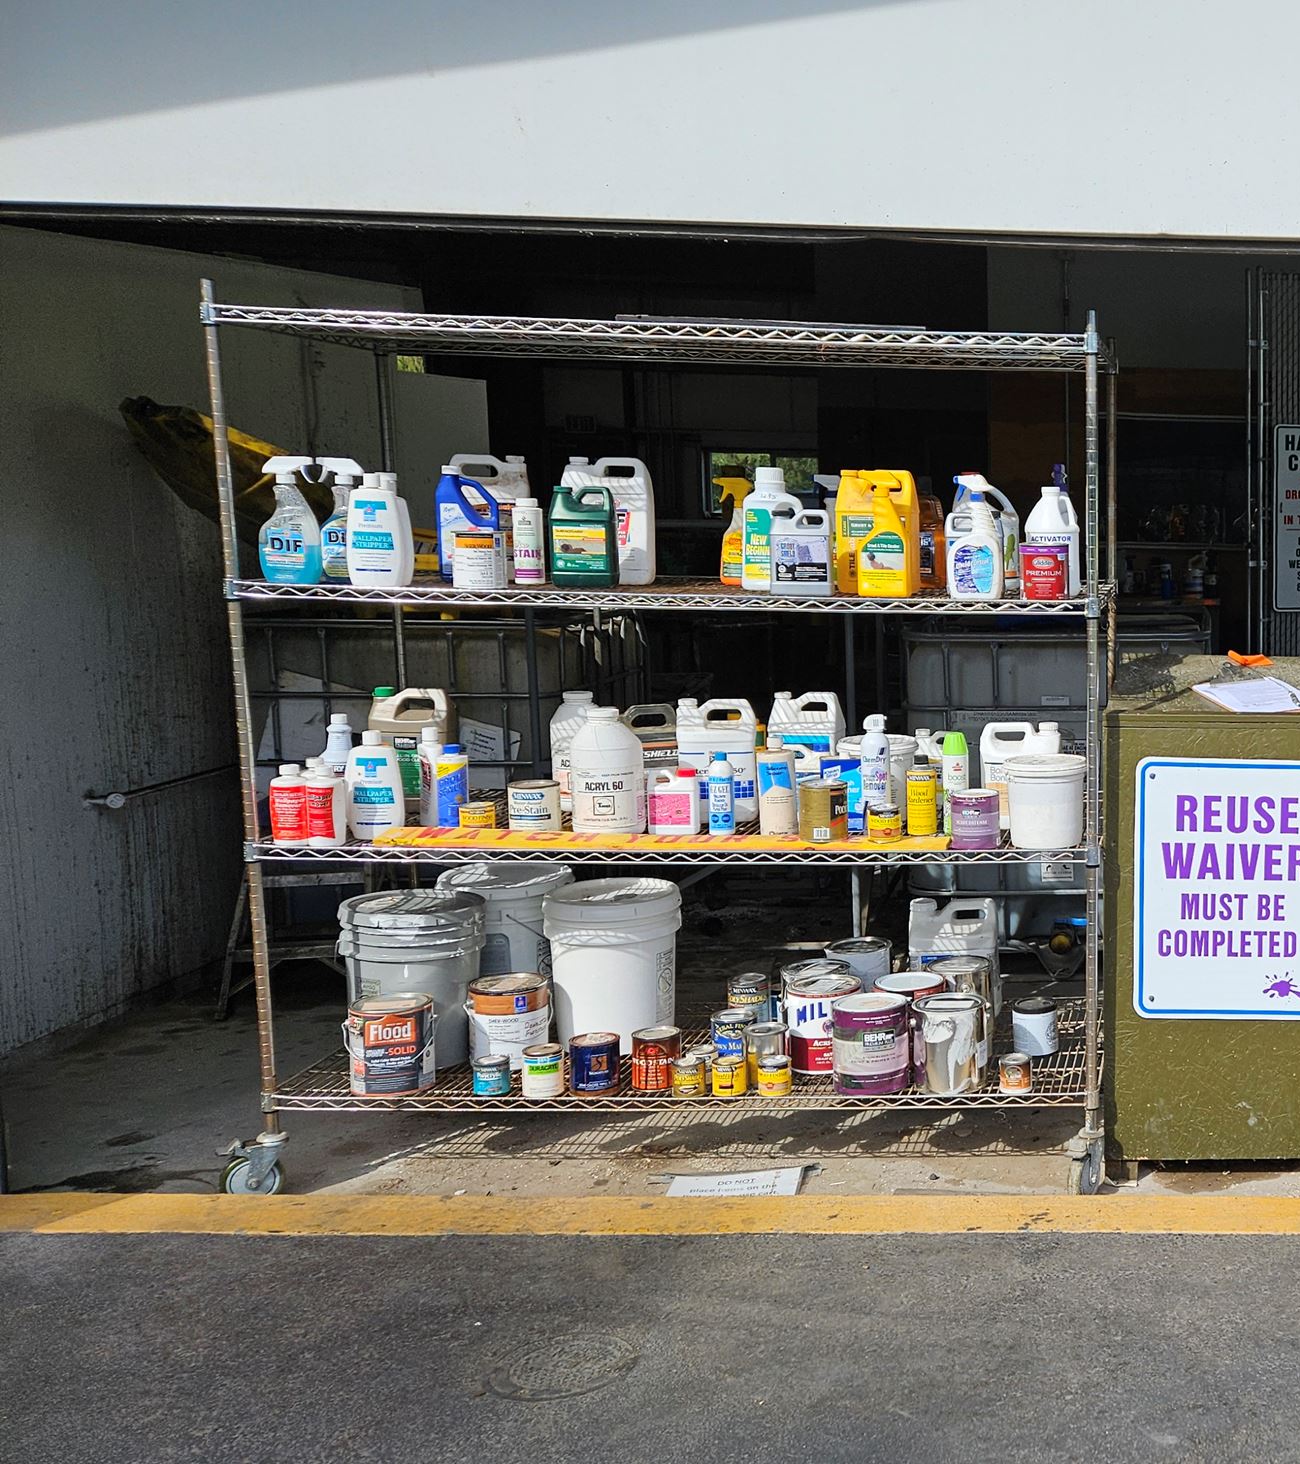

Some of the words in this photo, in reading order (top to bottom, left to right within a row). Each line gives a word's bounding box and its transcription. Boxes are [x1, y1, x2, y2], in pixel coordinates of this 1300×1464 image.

[1284, 516, 1294, 525] IN
[270, 538, 302, 552] DIF
[750, 534, 768, 545] NEW
[585, 782, 610, 791] ACRYL
[612, 781, 623, 790] 60
[510, 806, 548, 814] Pre-Stain
[1176, 794, 1300, 834] REUSE
[416, 829, 600, 842] WATCH
[1180, 893, 1248, 921] MUST
[1257, 894, 1285, 921] BE
[1158, 929, 1298, 958] COMPLETED
[370, 1022, 411, 1041] Flood
[864, 1033, 886, 1042] BEHR
